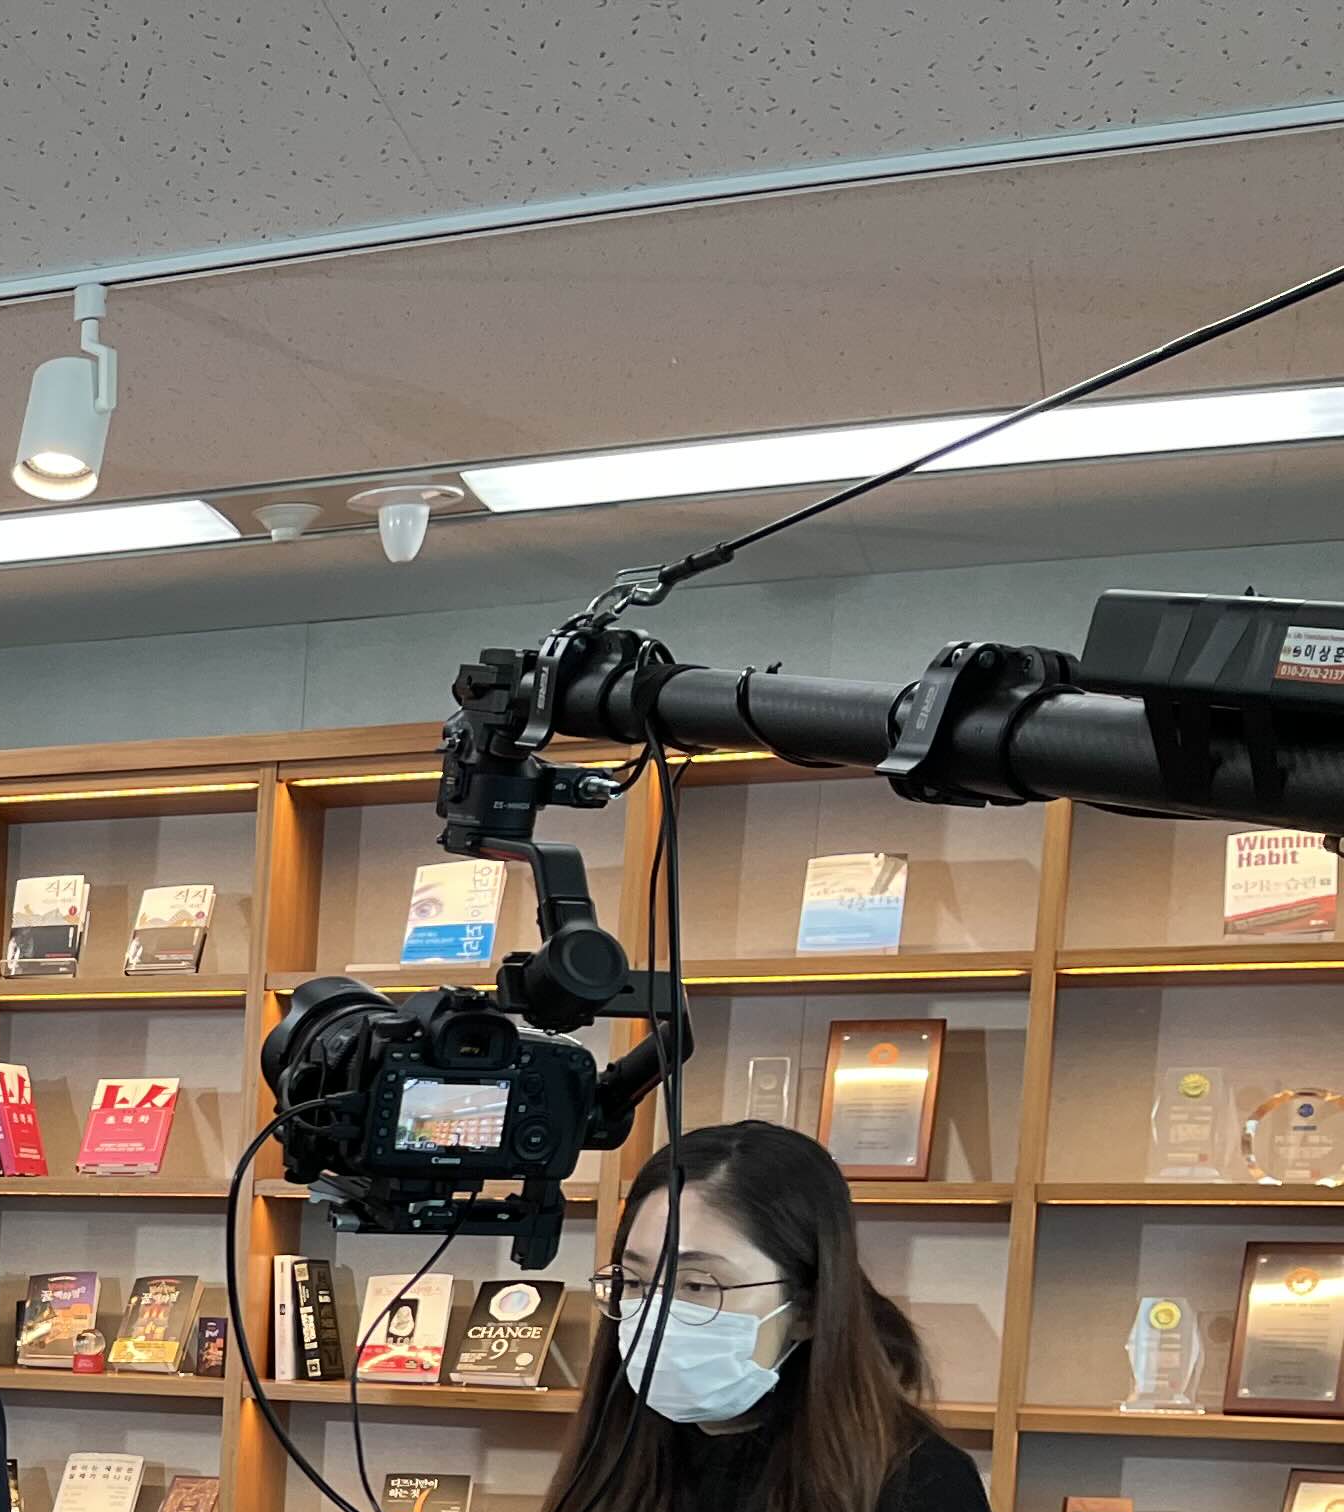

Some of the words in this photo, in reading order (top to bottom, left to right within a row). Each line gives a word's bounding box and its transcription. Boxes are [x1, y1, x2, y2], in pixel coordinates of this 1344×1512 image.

[1238, 850, 1298, 868] Habit
[467, 1326, 543, 1338] CHANGE
[490, 1338, 509, 1360] 9
[391, 1478, 439, 1489] 디즈니만이
[389, 1488, 408, 1498] 하는
[411, 1488, 421, 1498] 것
